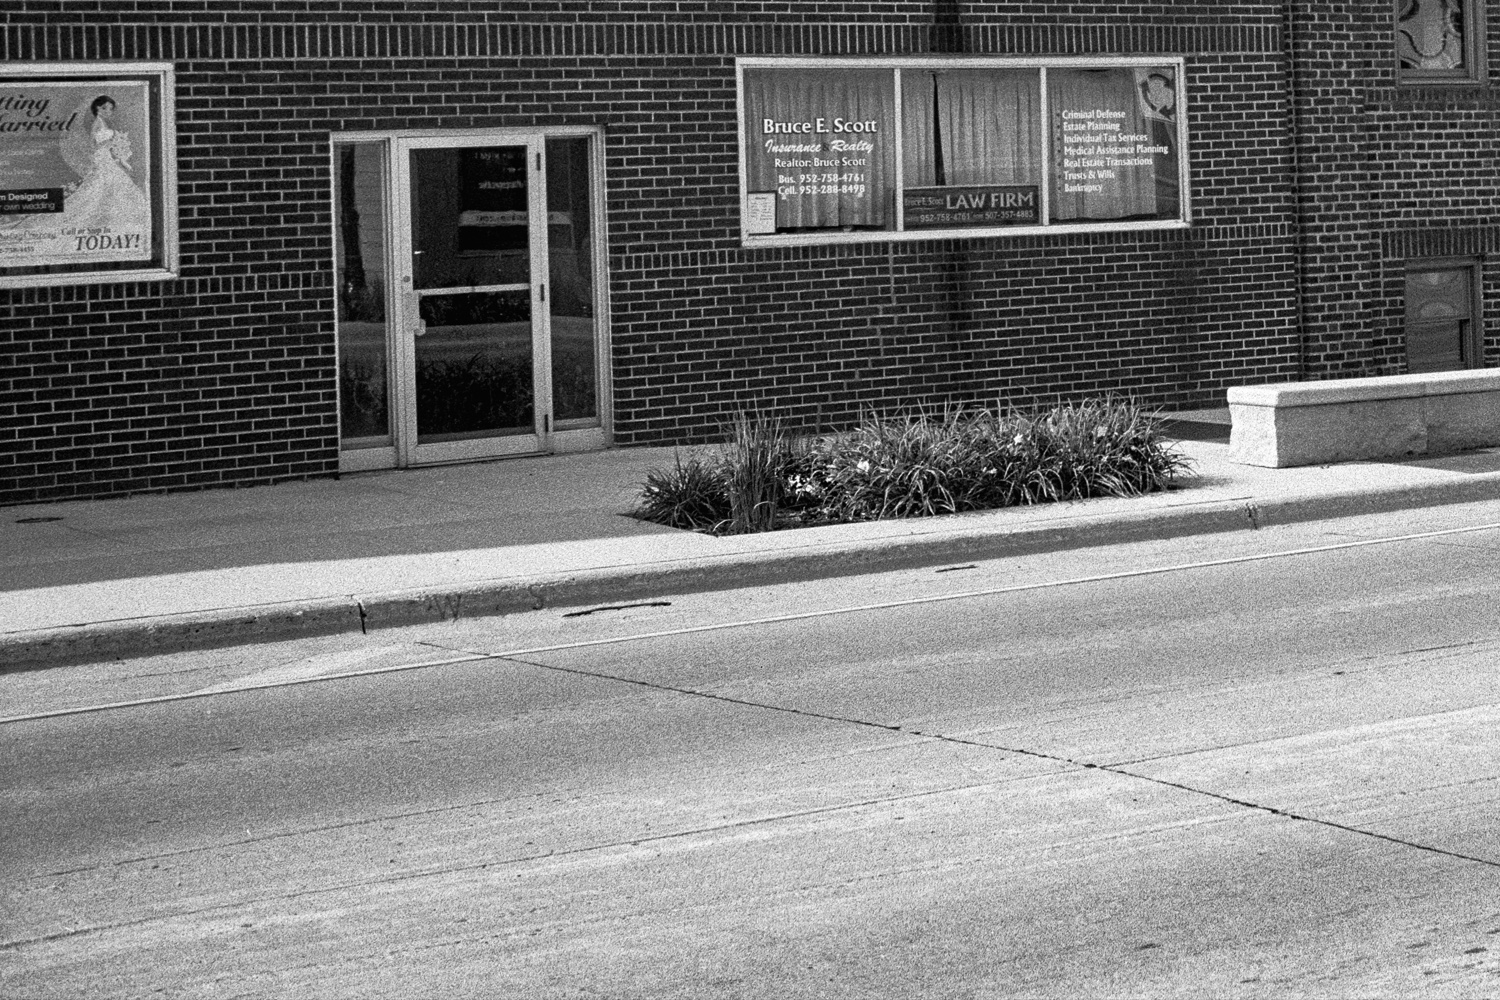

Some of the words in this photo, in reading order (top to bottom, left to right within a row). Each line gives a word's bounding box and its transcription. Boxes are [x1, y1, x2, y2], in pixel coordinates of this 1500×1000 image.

[1062, 110, 1095, 119] Criminal
[1096, 109, 1126, 118] Defense
[0, 112, 77, 131] arried
[763, 118, 812, 134] Bruce
[816, 117, 830, 133] E.
[833, 117, 877, 133] Scott
[1063, 121, 1086, 131] Estate
[1087, 121, 1121, 131] Planning
[1064, 134, 1101, 143] Individual
[1103, 133, 1117, 142] Tax
[1118, 133, 1148, 142] Services
[764, 139, 822, 153] Insurance
[831, 140, 874, 153] Realty
[1064, 146, 1095, 155] Medical
[1096, 145, 1135, 154] Assistance
[1136, 144, 1169, 155] Planning
[774, 158, 811, 167] Realtor:
[813, 157, 840, 166] Bruce
[841, 157, 866, 166] Scott
[1064, 158, 1081, 167] Real
[1082, 157, 1104, 167] Estate
[1105, 156, 1153, 167] Transactions
[778, 174, 796, 184] Bus.
[799, 173, 865, 183] 952-758-4761
[1064, 171, 1087, 180] Trusts
[1088, 171, 1096, 179] &
[1097, 170, 1115, 179] Wills
[778, 186, 797, 195] Cell.
[8, 192, 48, 201] Designed
[946, 193, 986, 209] LAW
[990, 192, 1033, 208] FIRM
[21, 202, 55, 210] wedding
[75, 234, 140, 251] TODAY!
